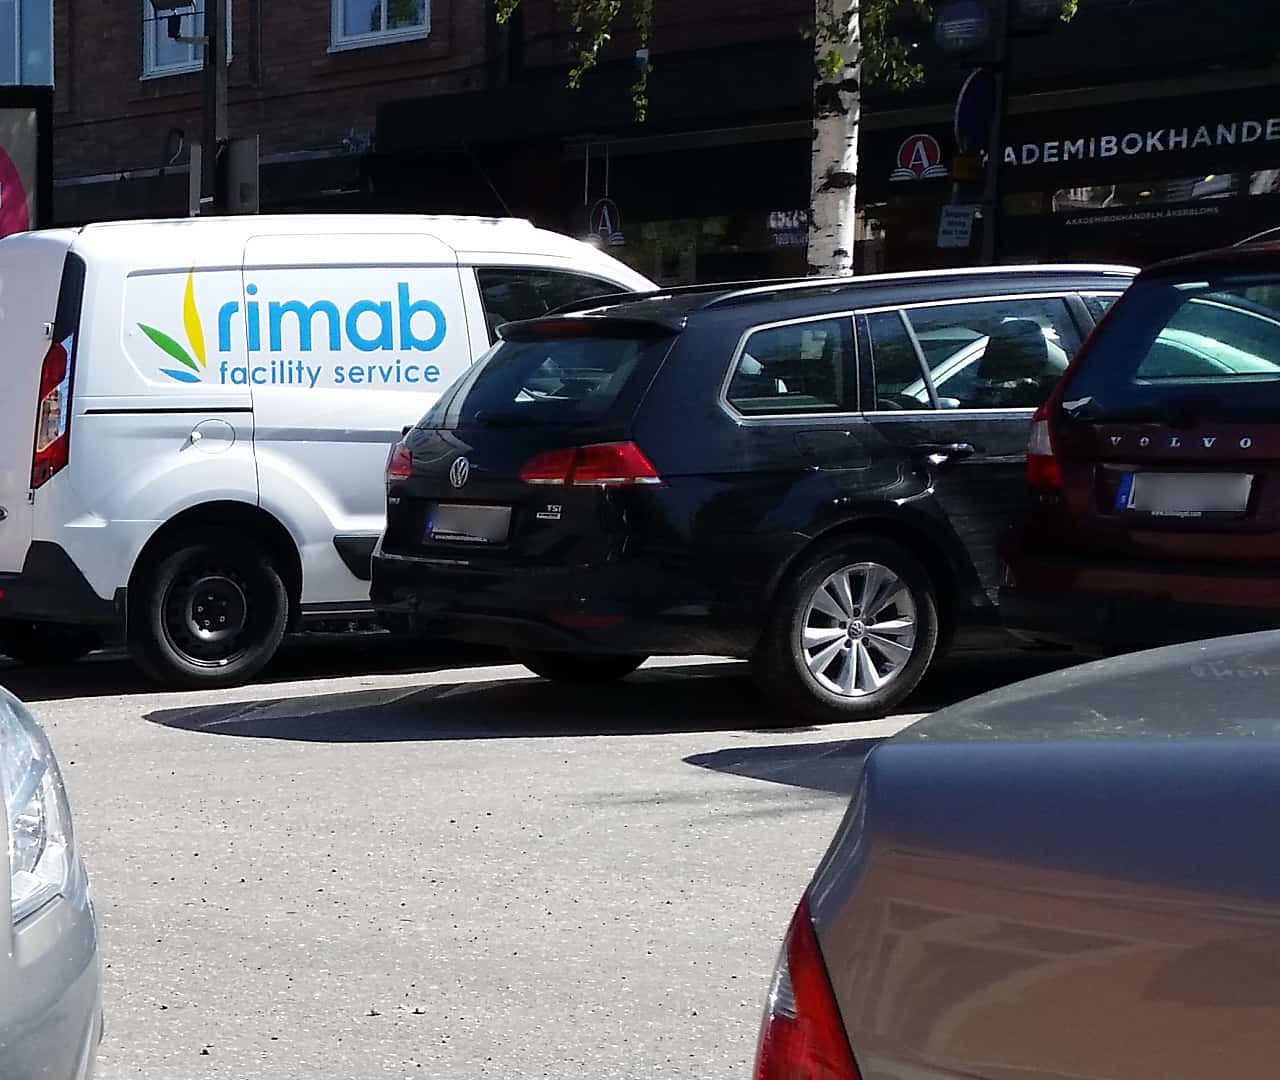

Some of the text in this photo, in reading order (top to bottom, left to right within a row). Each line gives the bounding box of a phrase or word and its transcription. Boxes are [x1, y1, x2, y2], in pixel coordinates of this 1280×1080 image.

[218, 282, 447, 352] rimab
[219, 360, 440, 388] facility service
[1110, 436, 1252, 448] VOLVO
